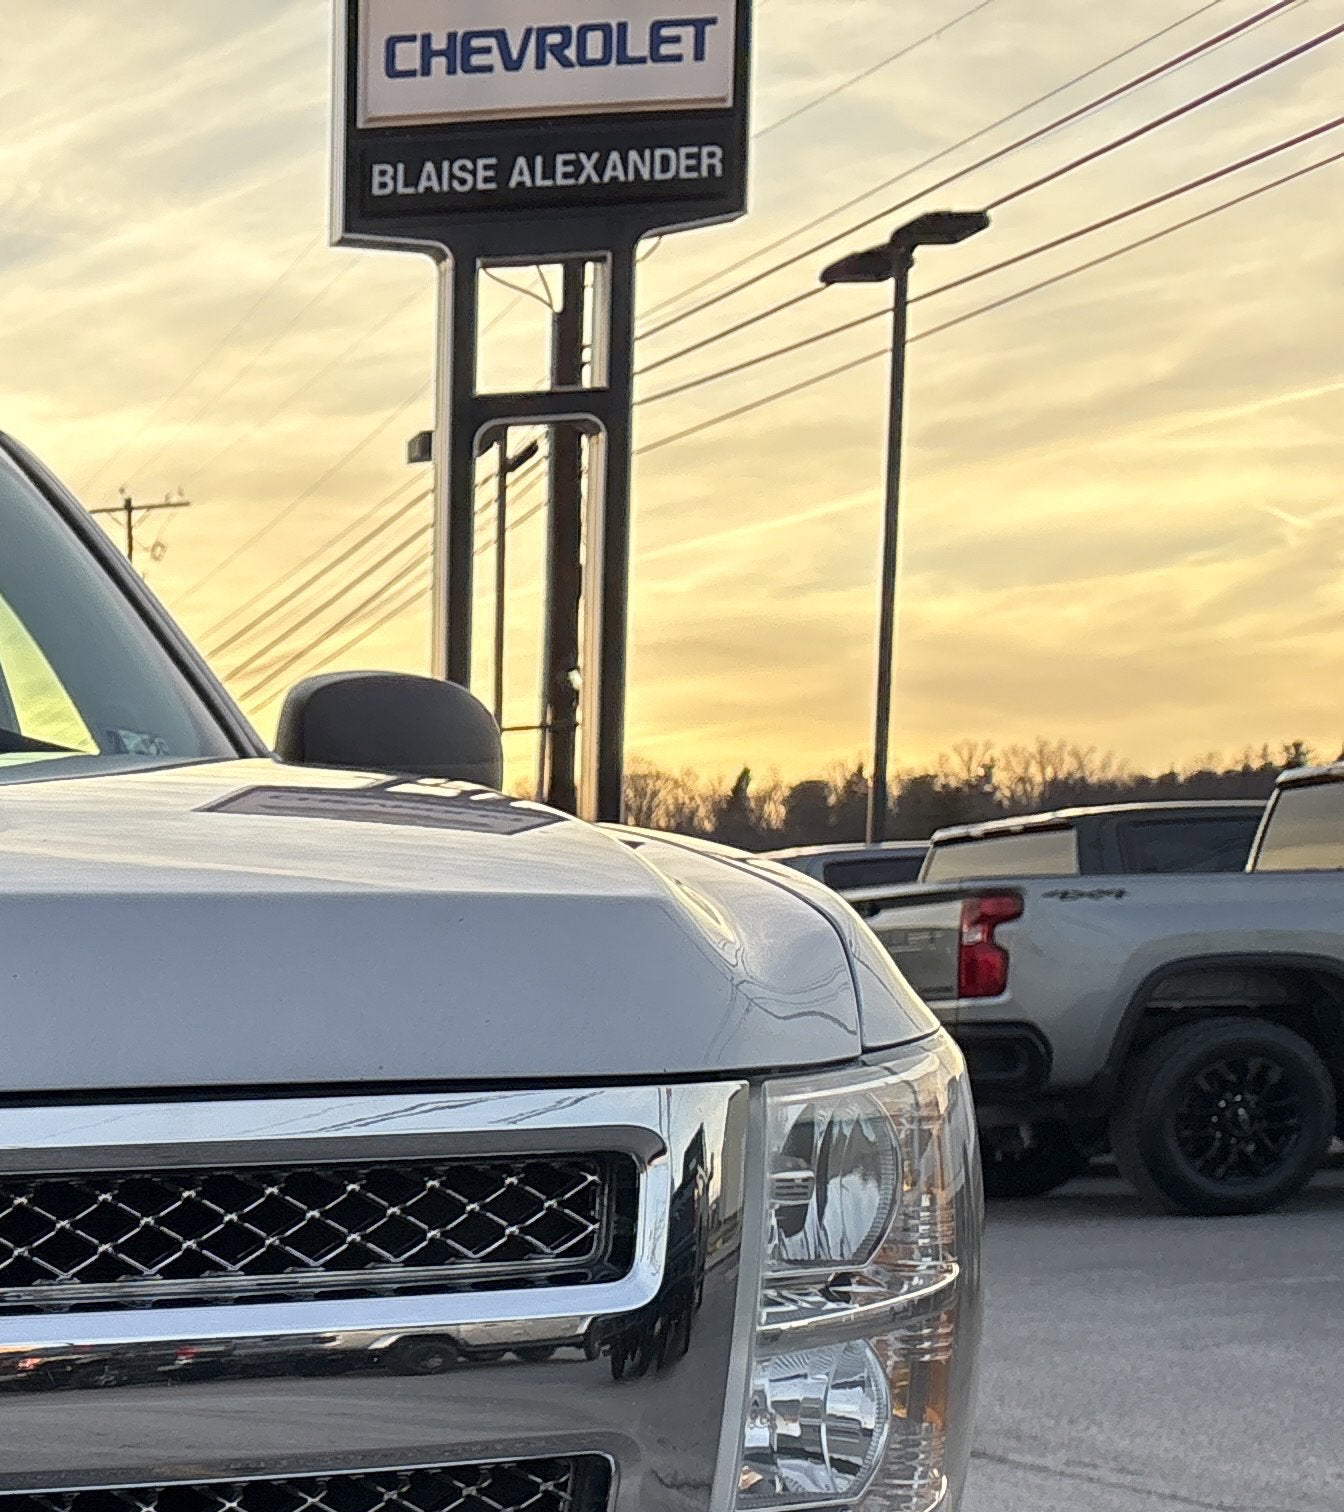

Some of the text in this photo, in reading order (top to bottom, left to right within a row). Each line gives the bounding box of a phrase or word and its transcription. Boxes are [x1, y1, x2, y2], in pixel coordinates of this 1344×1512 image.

[385, 16, 718, 79] CHEVROLET
[371, 145, 724, 197] BLAISE ALEXANDER
